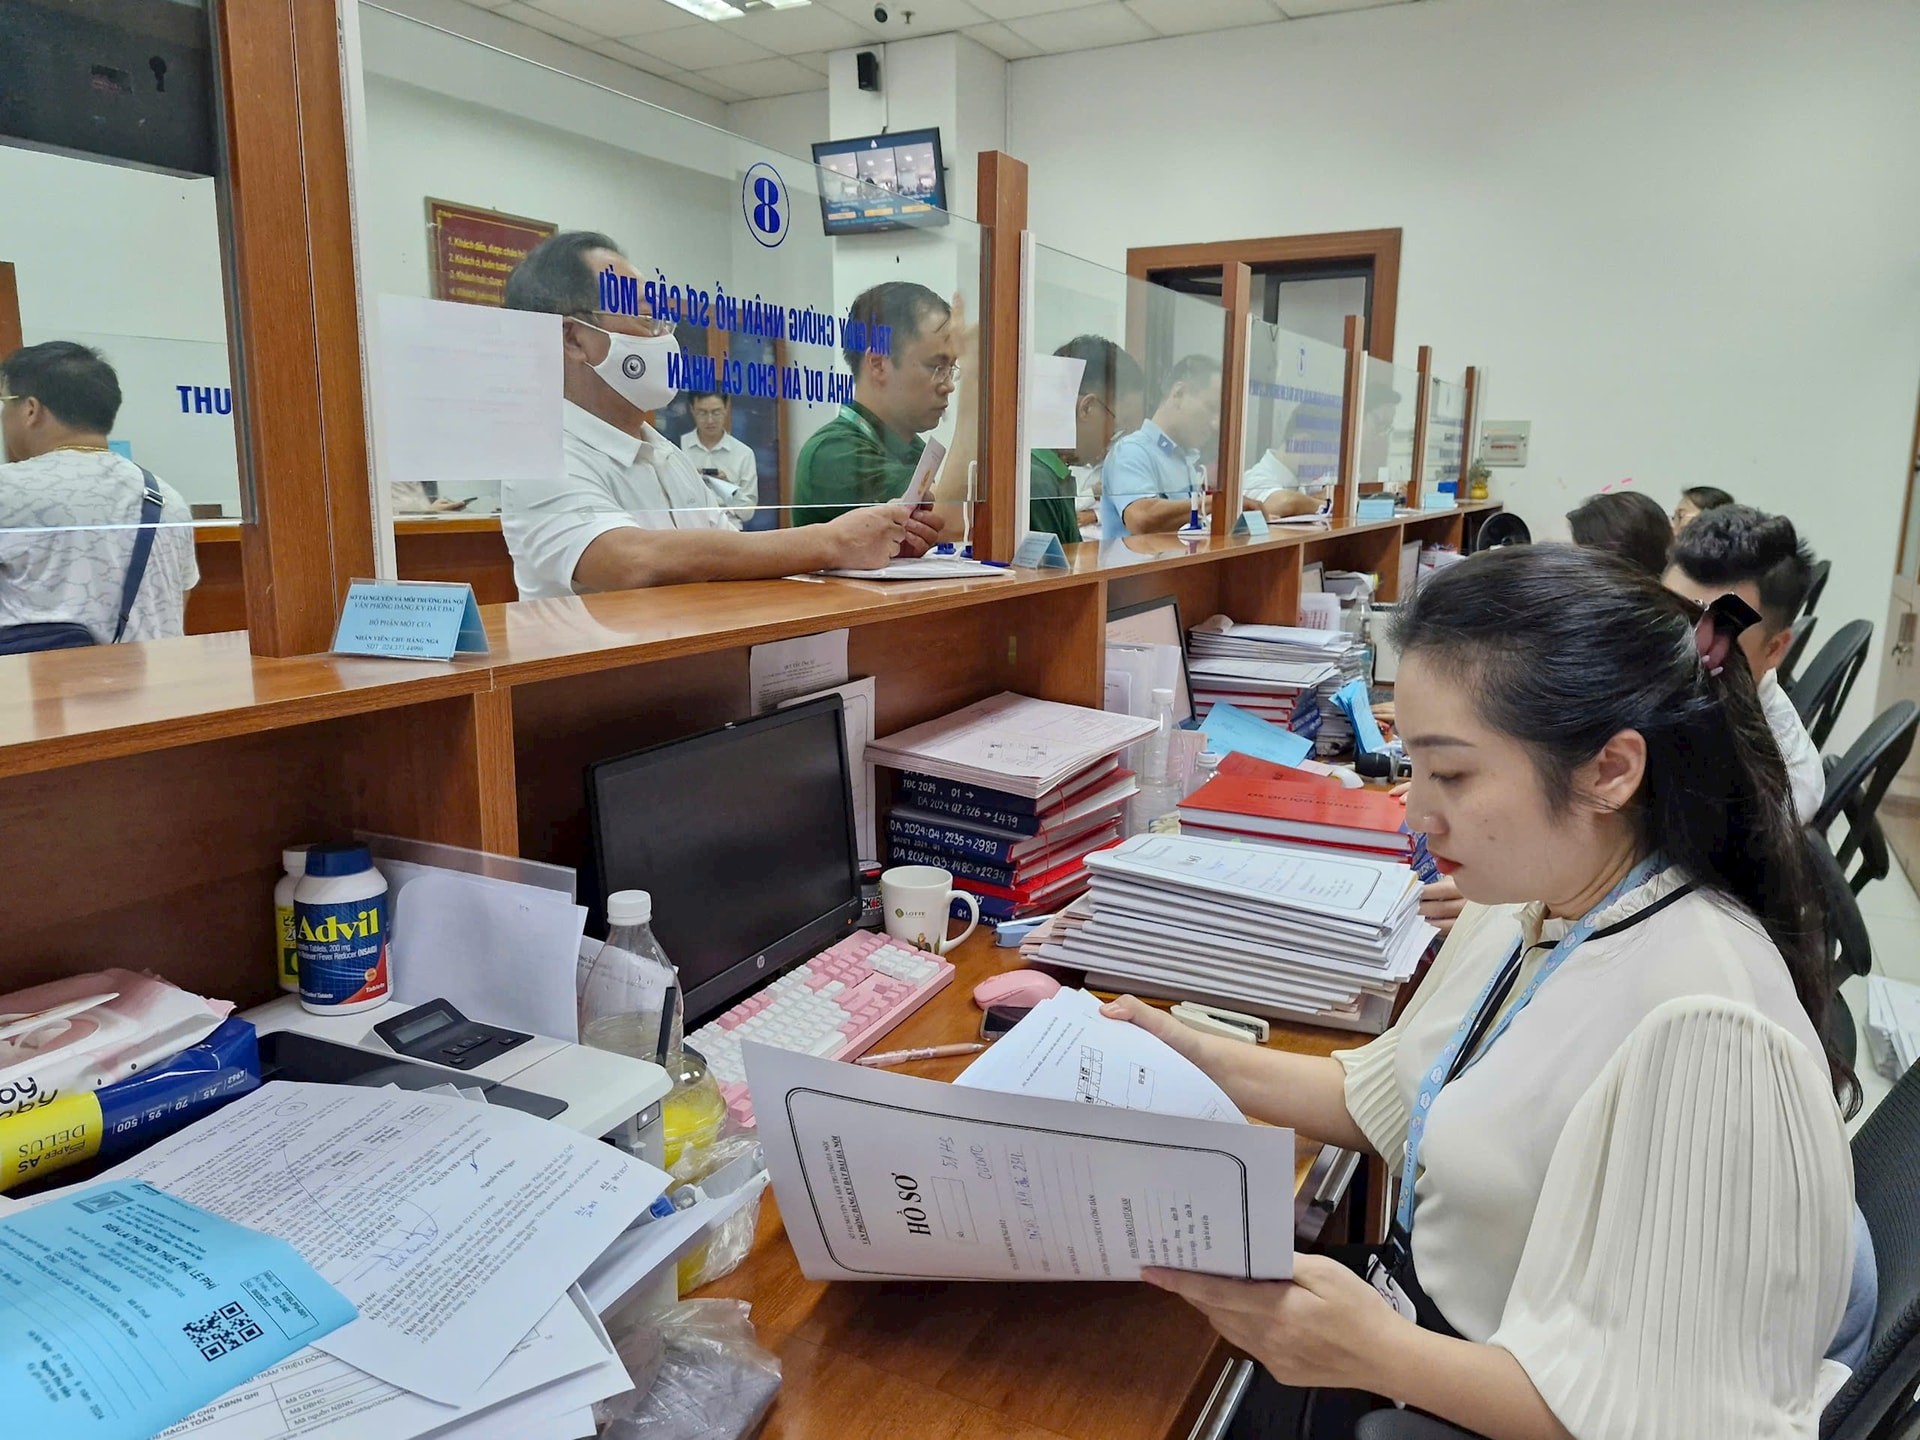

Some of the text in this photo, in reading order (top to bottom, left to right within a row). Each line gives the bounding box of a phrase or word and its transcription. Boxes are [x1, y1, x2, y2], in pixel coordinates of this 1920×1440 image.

[176, 385, 232, 415] THU
[972, 838, 997, 855] 2989
[297, 907, 379, 943] Advil
[203, 1088, 222, 1101] A5
[175, 1098, 189, 1112] 70
[148, 1108, 163, 1123] 95
[117, 1117, 138, 1133] 500
[18, 1123, 86, 1158] DELUS
[891, 1172, 931, 1237] HỒ SƠ
[197, 1276, 217, 1291] PHÍ
[196, 1390, 260, 1417] CHO KBNN GHI
